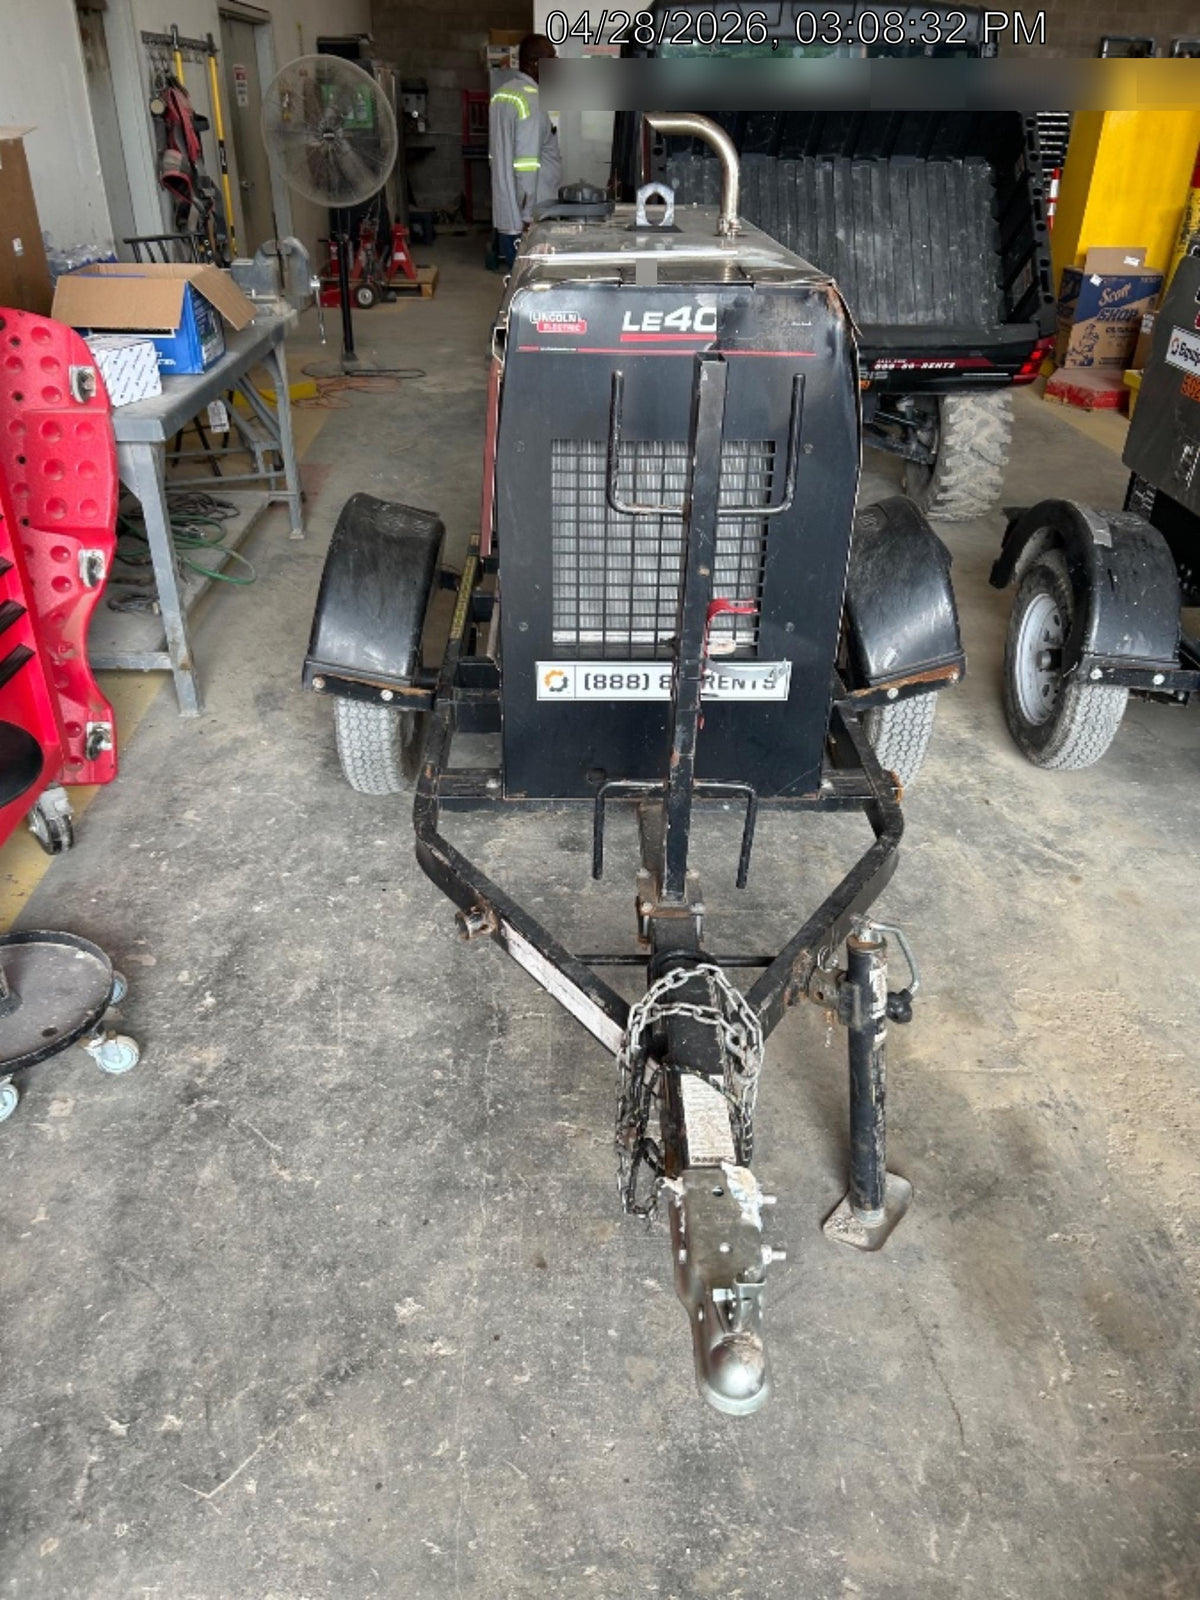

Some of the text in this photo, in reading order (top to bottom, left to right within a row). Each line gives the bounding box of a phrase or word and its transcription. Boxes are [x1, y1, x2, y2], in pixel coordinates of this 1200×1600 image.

[532, 311, 577, 323] LINCOLN
[1097, 308, 1139, 321] SHOP
[584, 672, 650, 691] (888)
